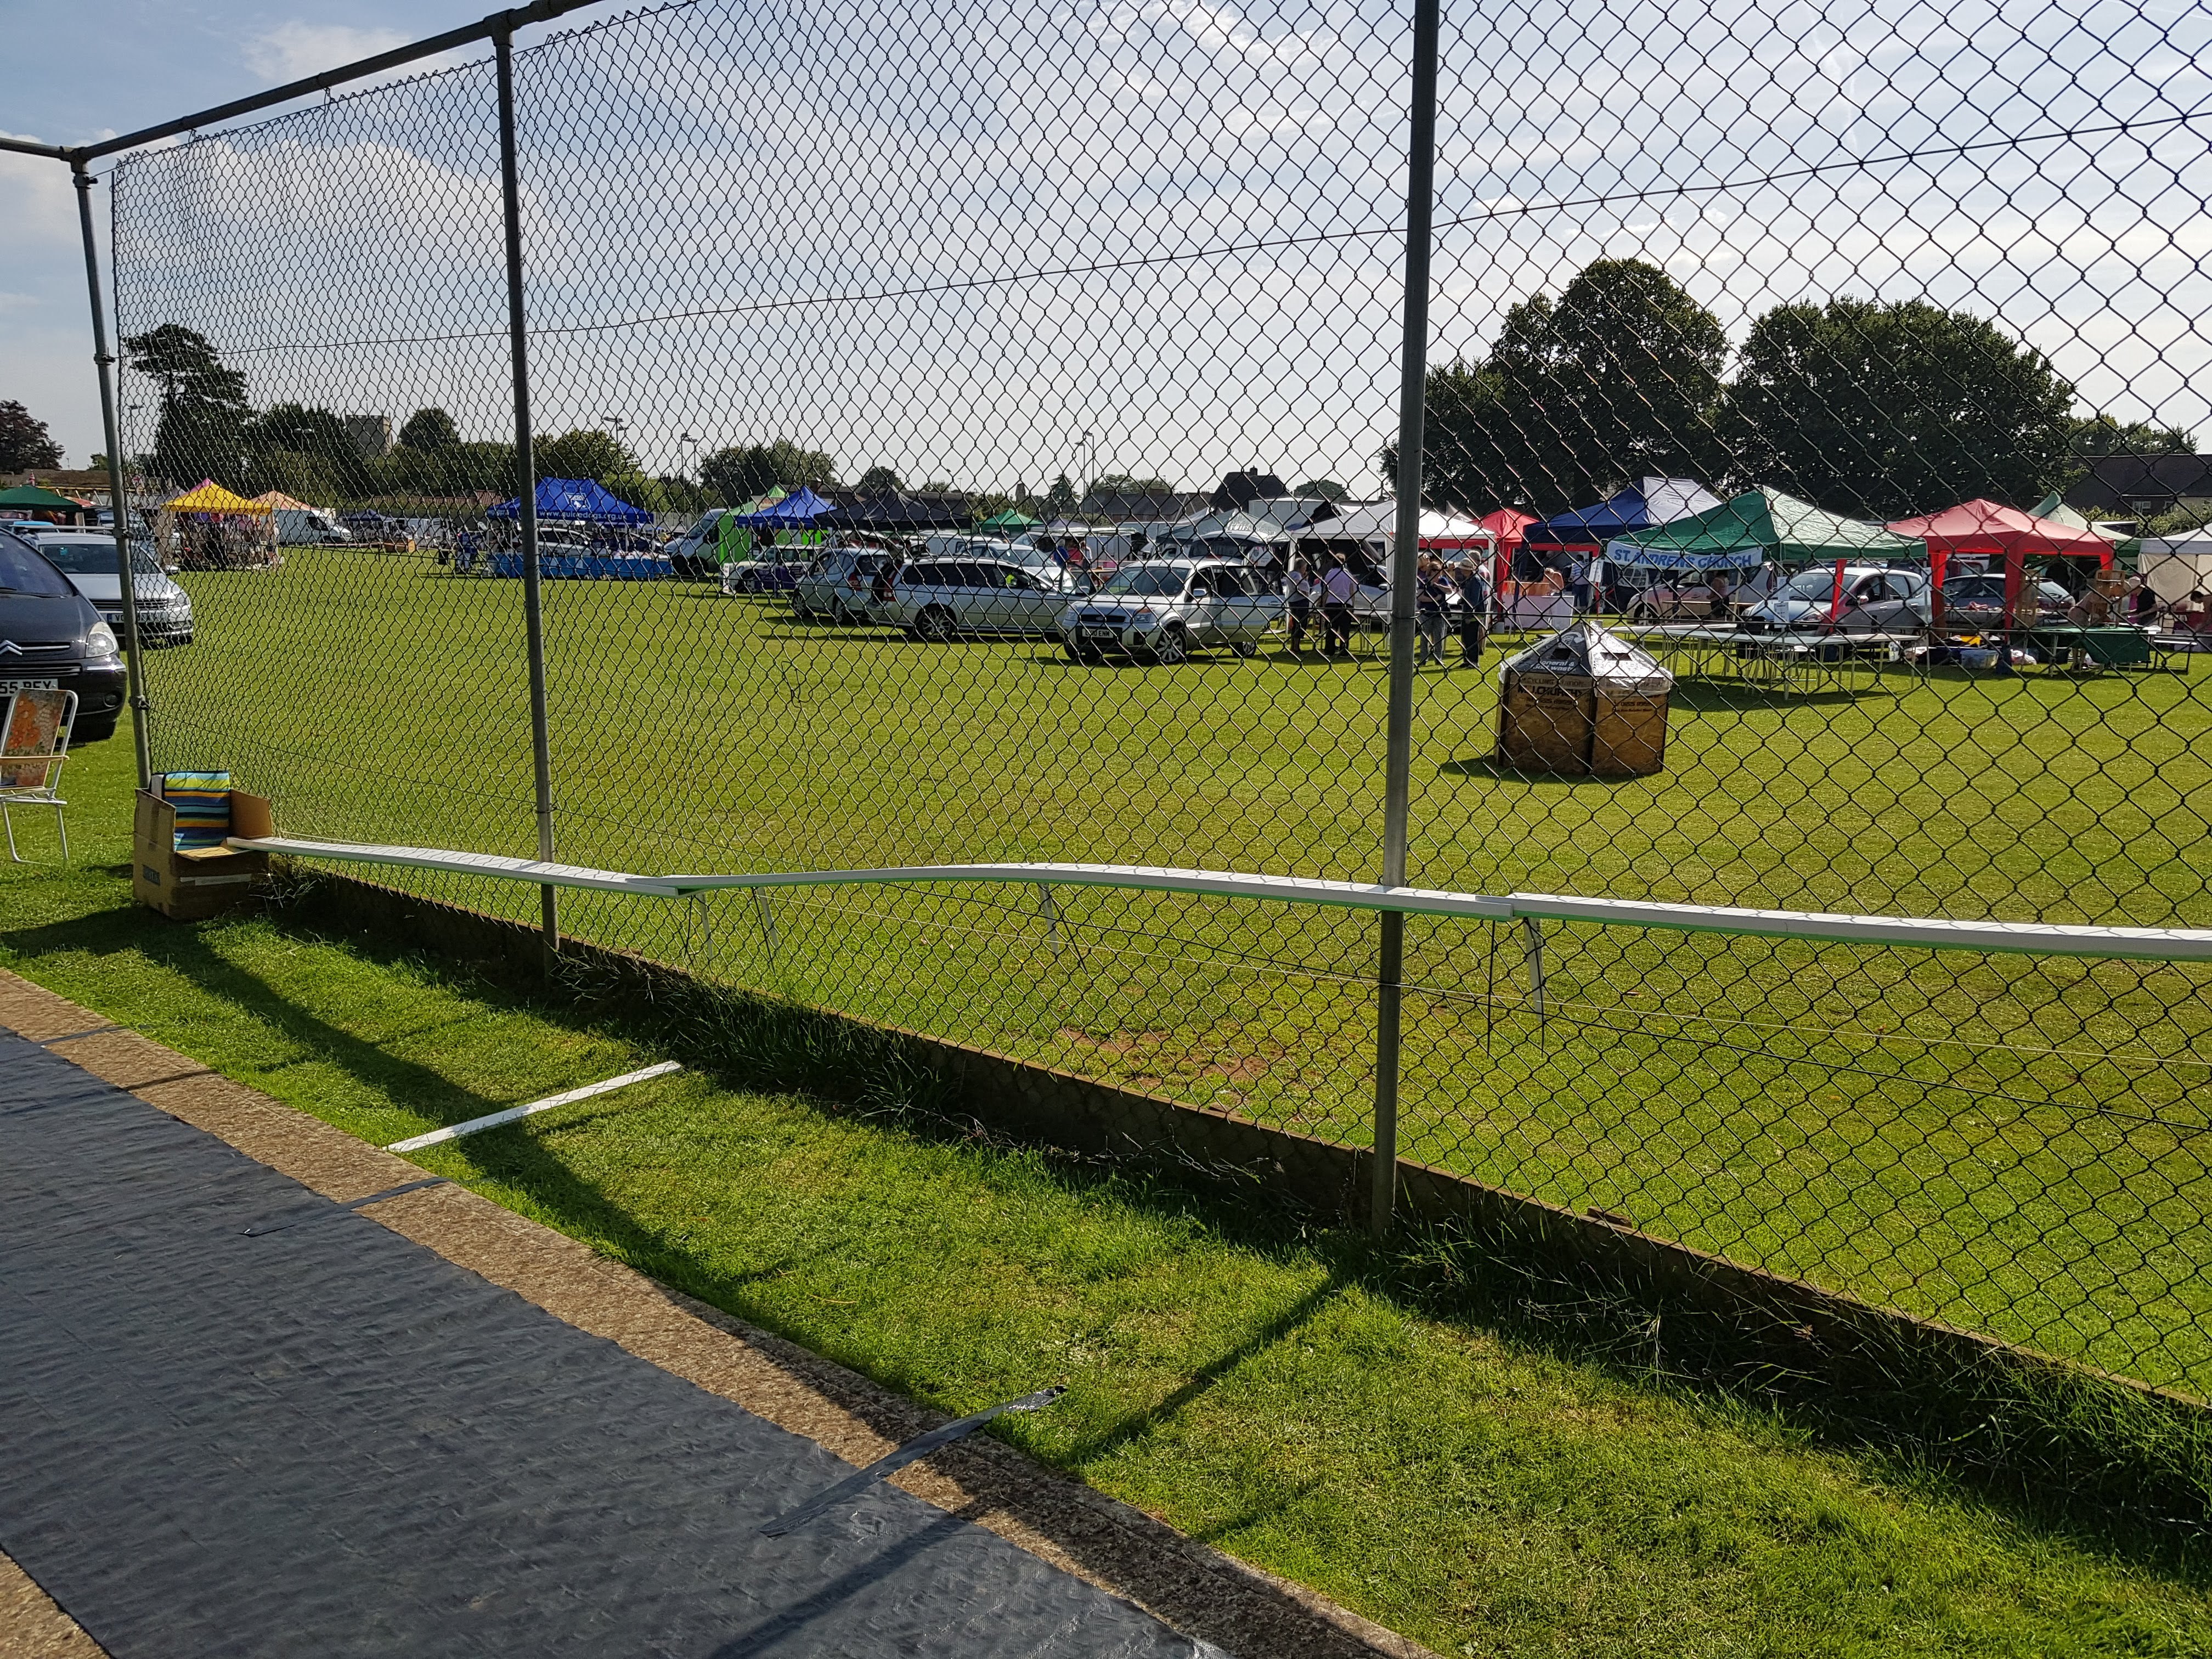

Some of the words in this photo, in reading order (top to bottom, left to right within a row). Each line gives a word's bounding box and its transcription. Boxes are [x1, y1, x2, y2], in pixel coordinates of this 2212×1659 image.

[539, 511, 627, 521] www.guidedogs.org.uk
[1614, 549, 1630, 562] ST.
[1698, 555, 1752, 567] CHURCH
